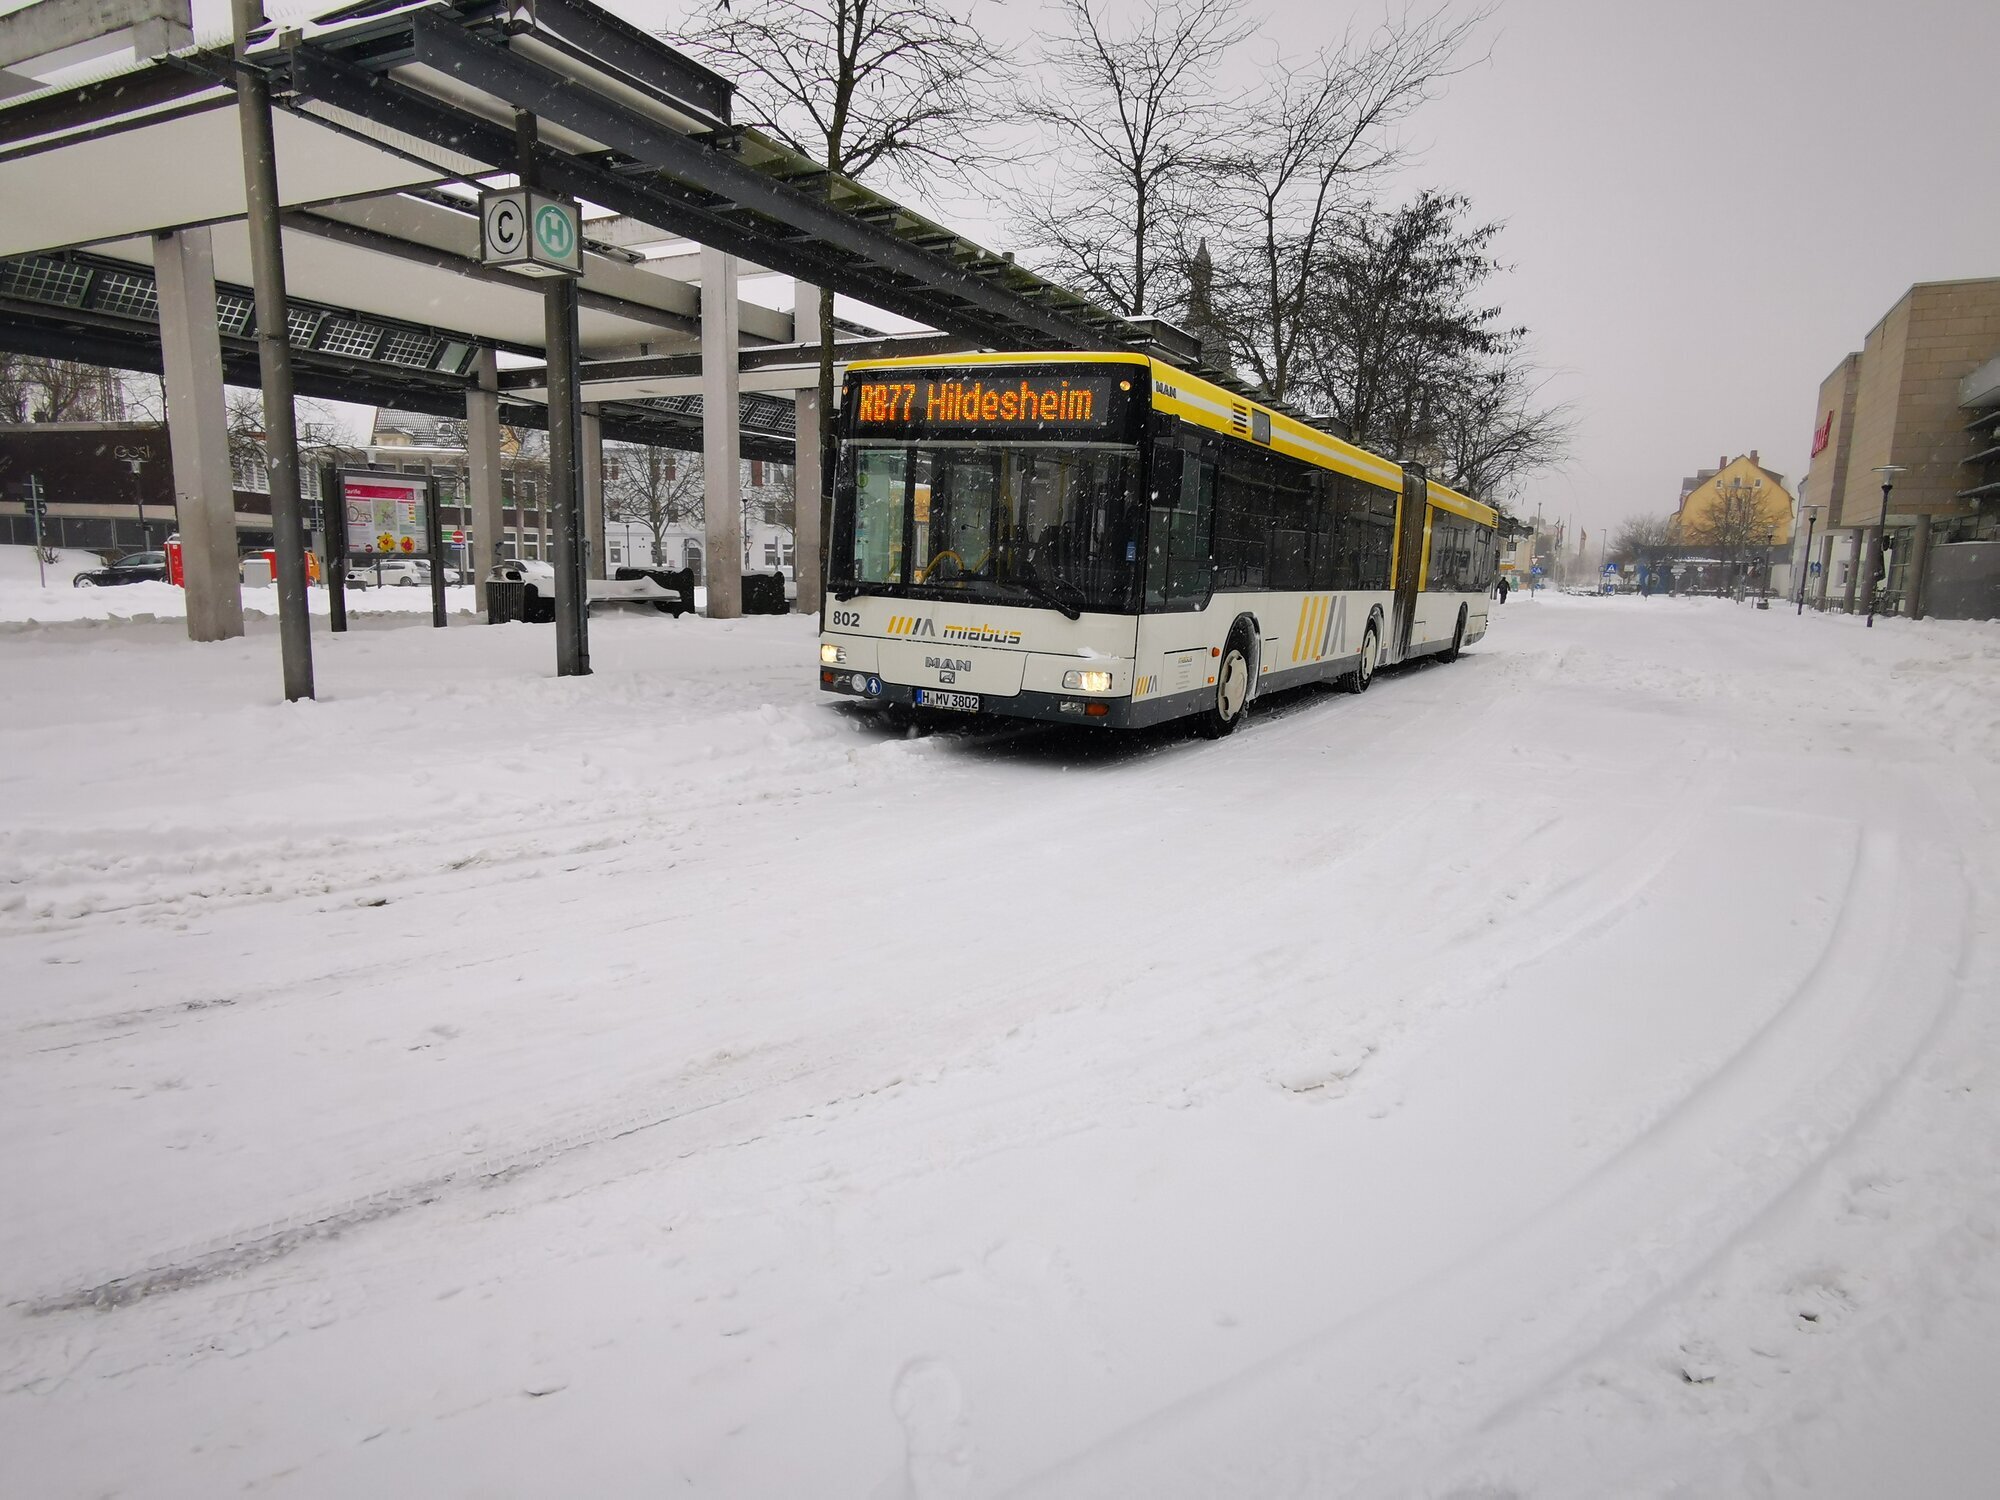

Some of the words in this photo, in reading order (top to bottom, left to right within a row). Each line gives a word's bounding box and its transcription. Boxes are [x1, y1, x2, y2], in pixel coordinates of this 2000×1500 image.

[498, 210, 514, 243] C
[544, 215, 564, 248] H
[1156, 380, 1177, 399] MAN
[859, 383, 917, 422] RB77
[926, 381, 1093, 421] Hildesheim
[833, 610, 860, 627] 802
[943, 624, 1022, 645] miabus
[925, 656, 972, 672] MAN
[922, 691, 930, 703] H
[935, 693, 950, 706] MV
[952, 694, 979, 710] 3802
